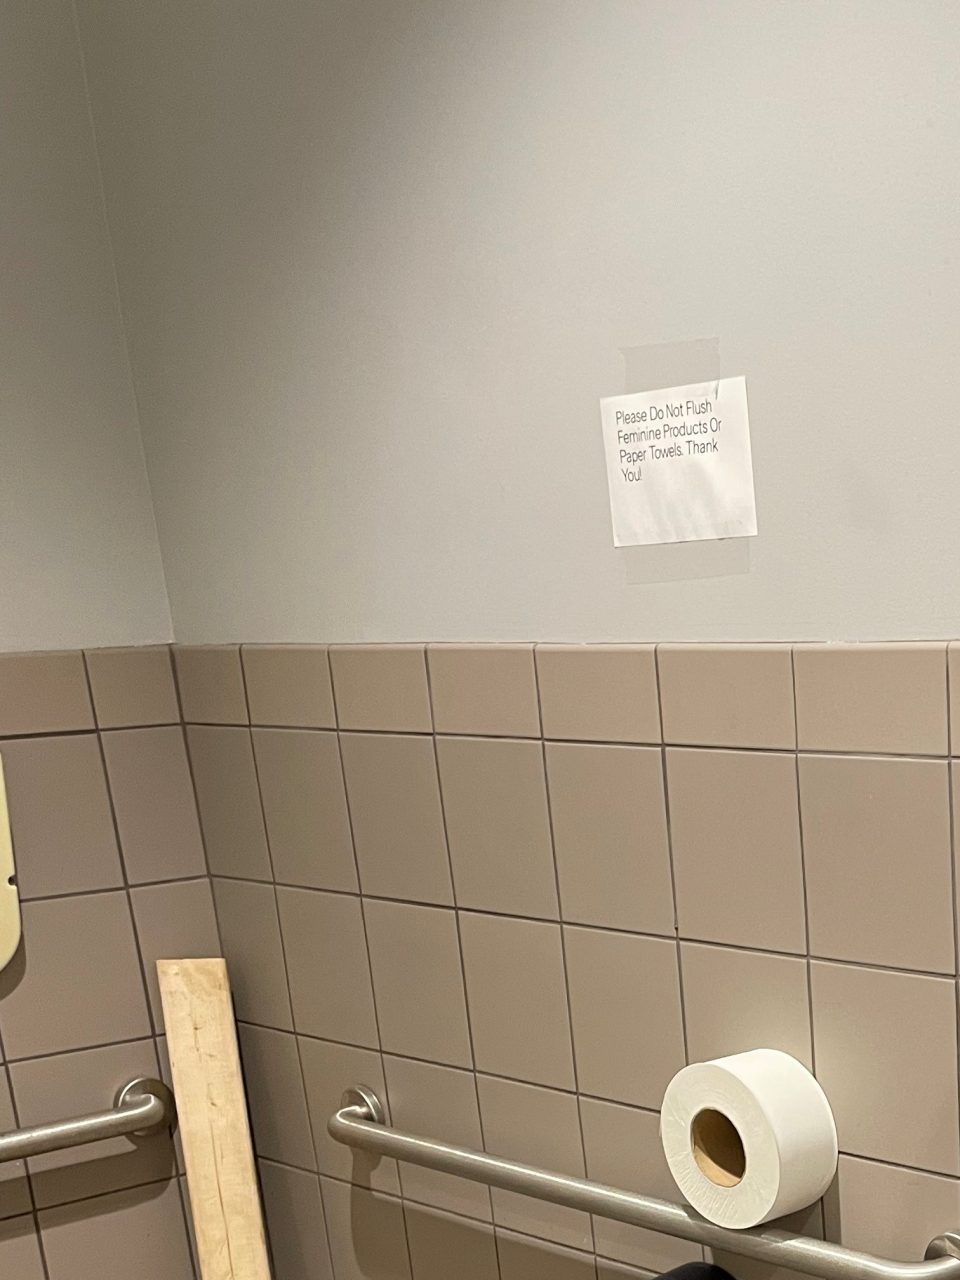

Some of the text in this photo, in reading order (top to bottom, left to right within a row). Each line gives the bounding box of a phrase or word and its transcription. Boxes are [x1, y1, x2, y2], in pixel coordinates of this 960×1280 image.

[615, 400, 712, 425] Please Do Not Flush
[617, 417, 722, 445] Feminine Products Or
[619, 438, 719, 466] Paper Towels. Thank
[621, 467, 643, 482] You!
